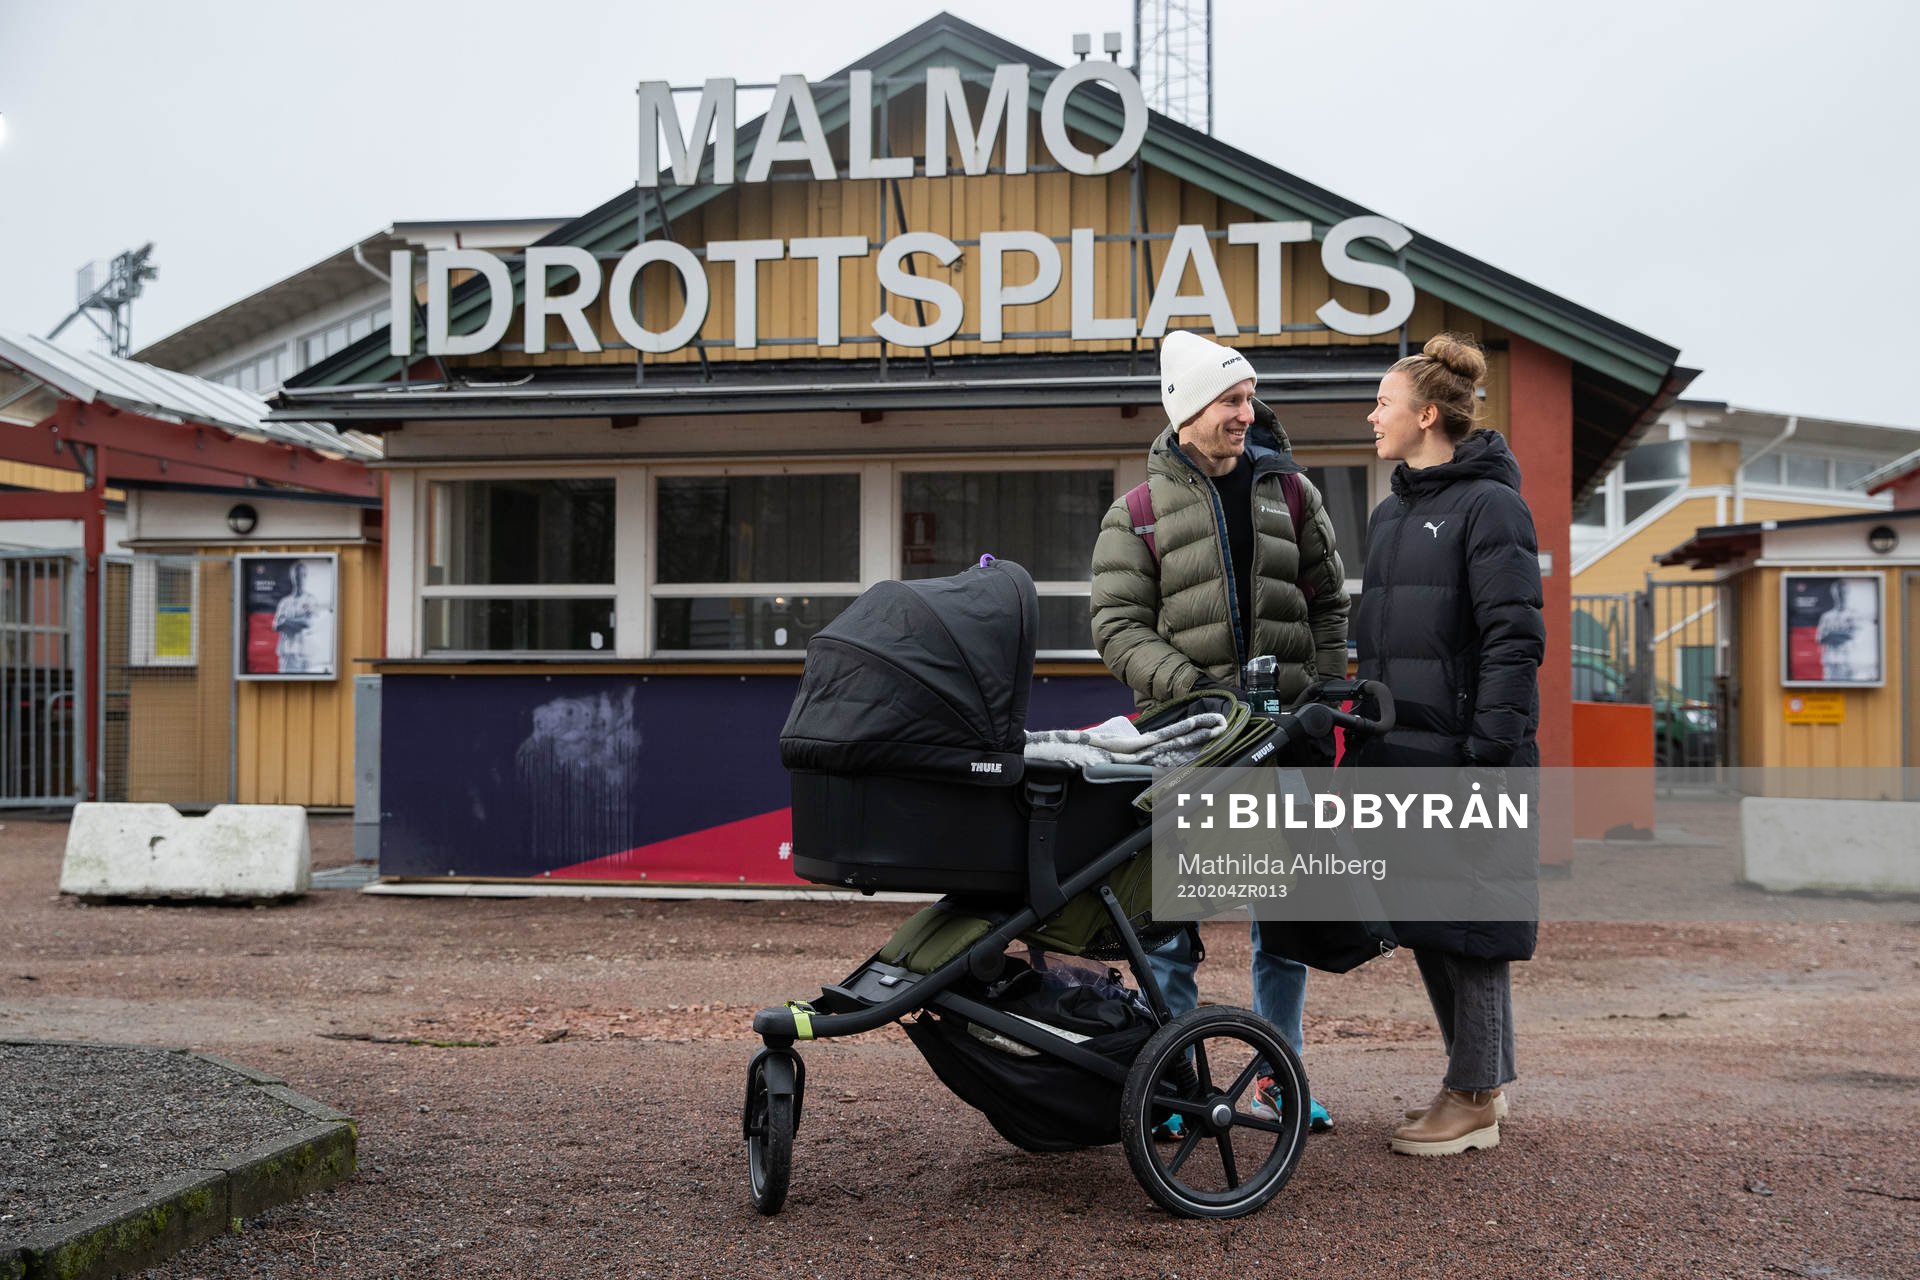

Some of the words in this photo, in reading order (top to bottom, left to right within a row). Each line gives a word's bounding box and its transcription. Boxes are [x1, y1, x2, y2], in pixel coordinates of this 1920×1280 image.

[638, 32, 1149, 188] MALMÖ
[390, 215, 1415, 356] IDROTTSPLATS
[970, 762, 1002, 773] THULE
[1251, 742, 1275, 762] THULE
